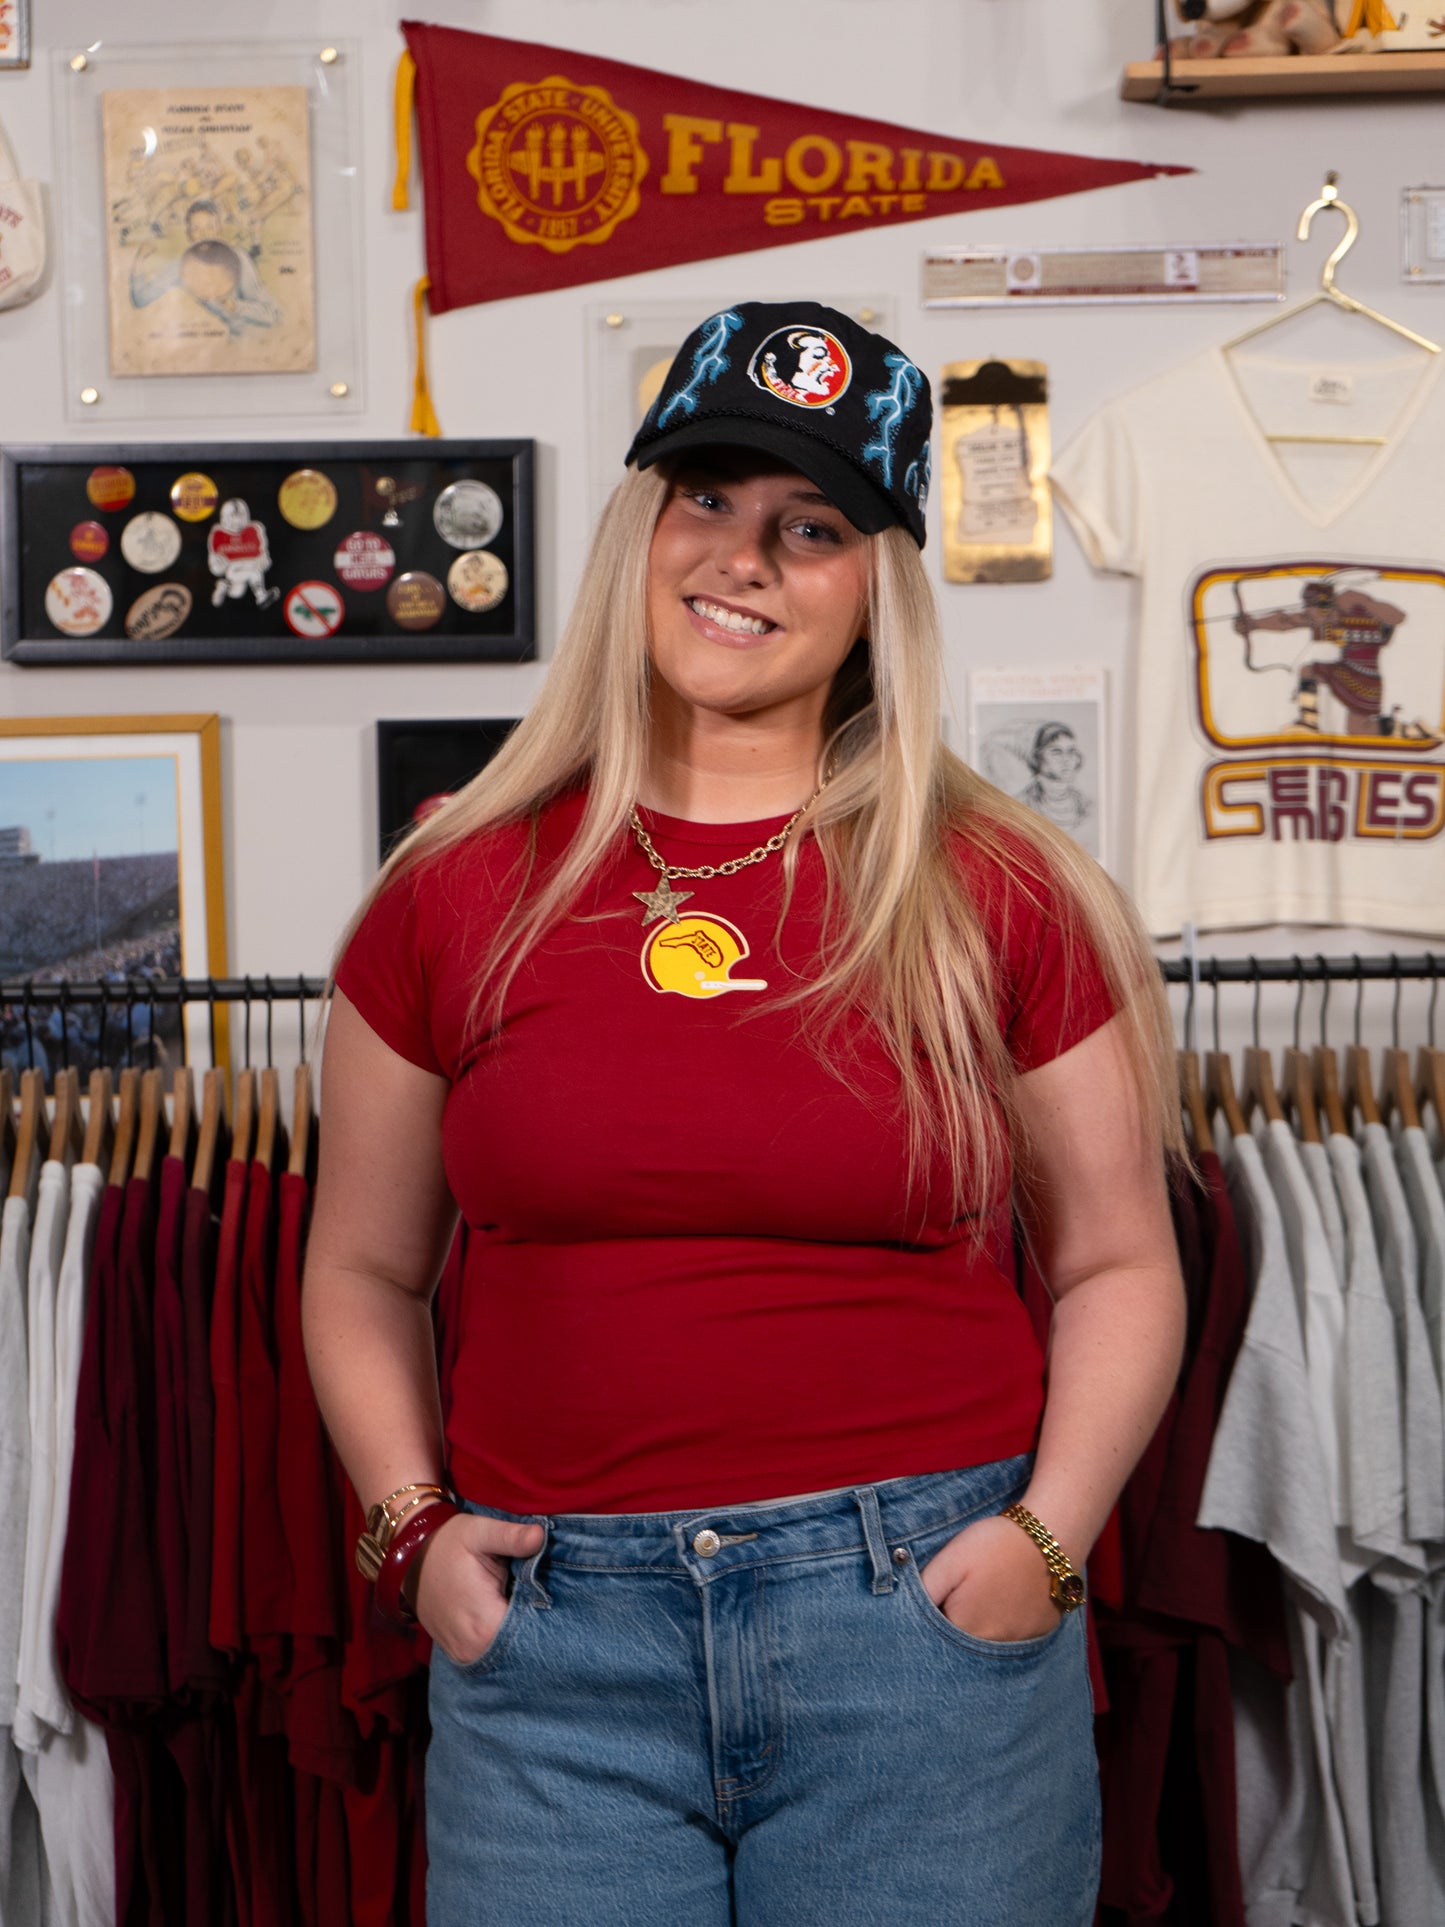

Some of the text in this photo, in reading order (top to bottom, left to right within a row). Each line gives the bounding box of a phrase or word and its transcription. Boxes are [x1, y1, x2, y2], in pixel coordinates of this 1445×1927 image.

[484, 89, 635, 222] FLORIDA STATE UNIVERSITY
[661, 113, 1005, 195] FLORIDA
[764, 193, 926, 226] STATE
[345, 536, 381, 550] GO TO
[692, 935, 716, 957] STATE
